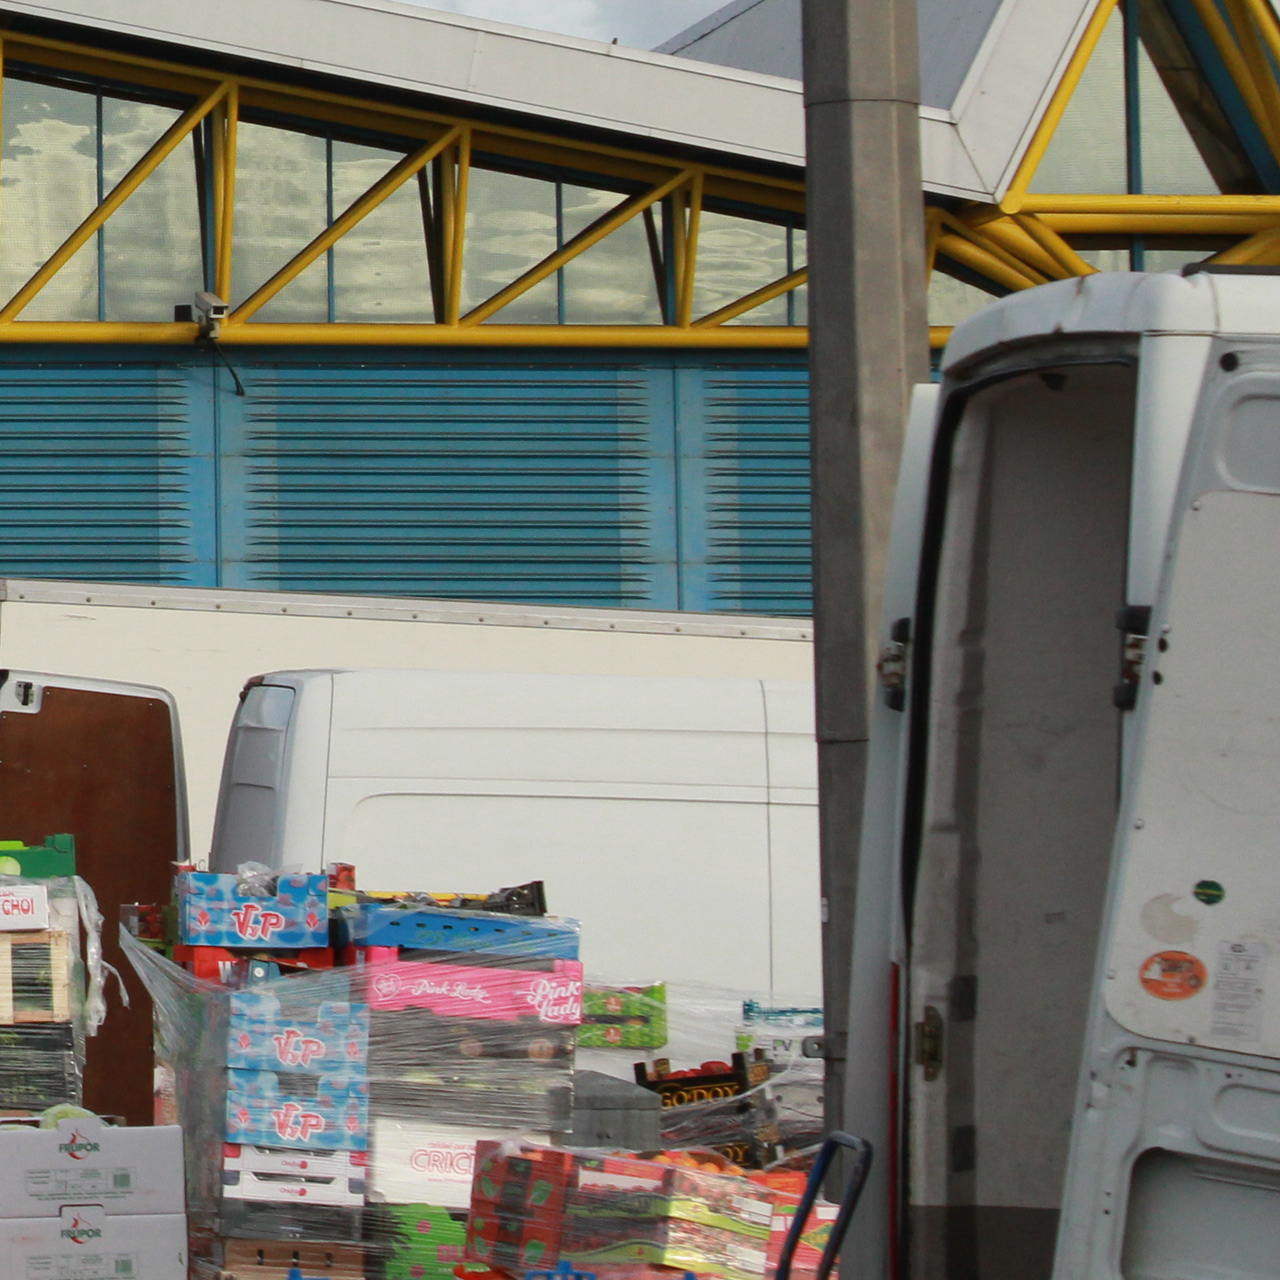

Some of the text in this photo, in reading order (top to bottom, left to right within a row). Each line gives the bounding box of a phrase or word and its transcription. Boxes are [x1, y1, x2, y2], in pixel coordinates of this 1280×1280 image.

[1, 898, 35, 916] CHOI
[406, 978, 450, 996] Pink
[449, 981, 492, 1004] Lady
[526, 978, 582, 1005] Pink
[538, 998, 582, 1022] Lady
[58, 1142, 100, 1153] FRUPOR
[60, 1228, 102, 1239] FRUPOR
